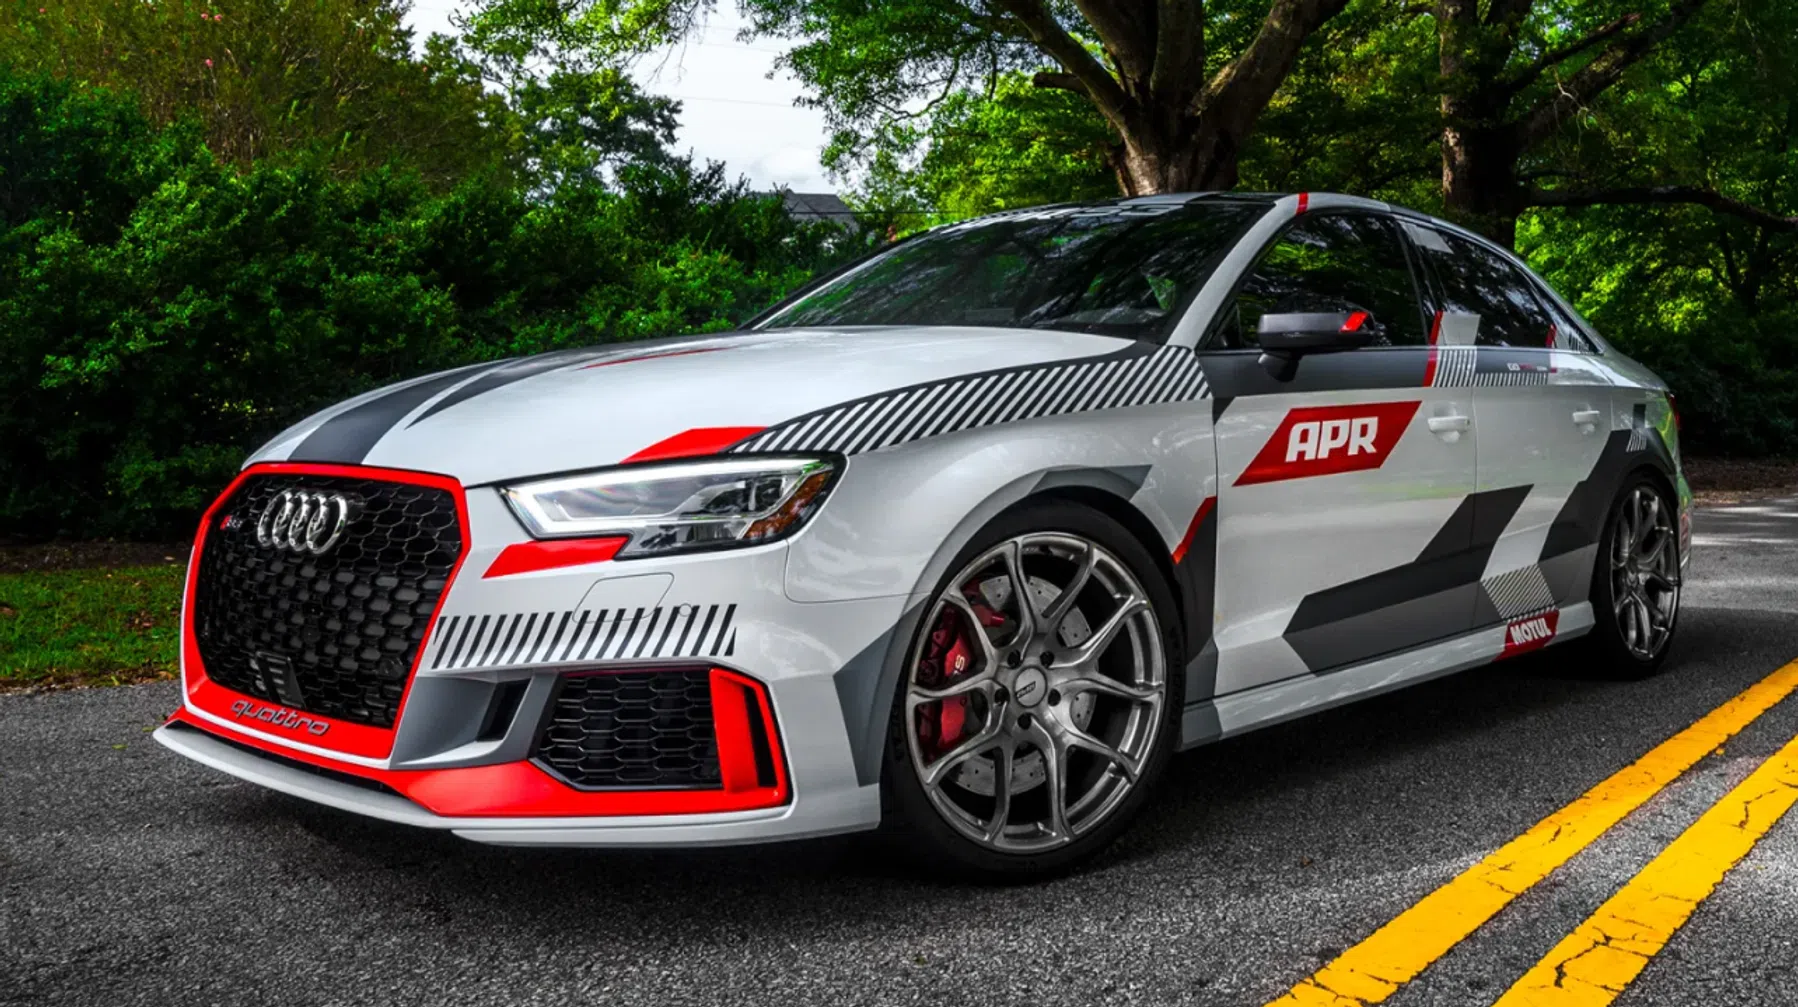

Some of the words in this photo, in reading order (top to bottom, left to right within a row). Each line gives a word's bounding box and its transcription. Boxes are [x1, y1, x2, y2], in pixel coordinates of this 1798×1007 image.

[1286, 416, 1379, 463] APR
[1510, 617, 1552, 645] MOTUL
[231, 700, 330, 736] quattro
